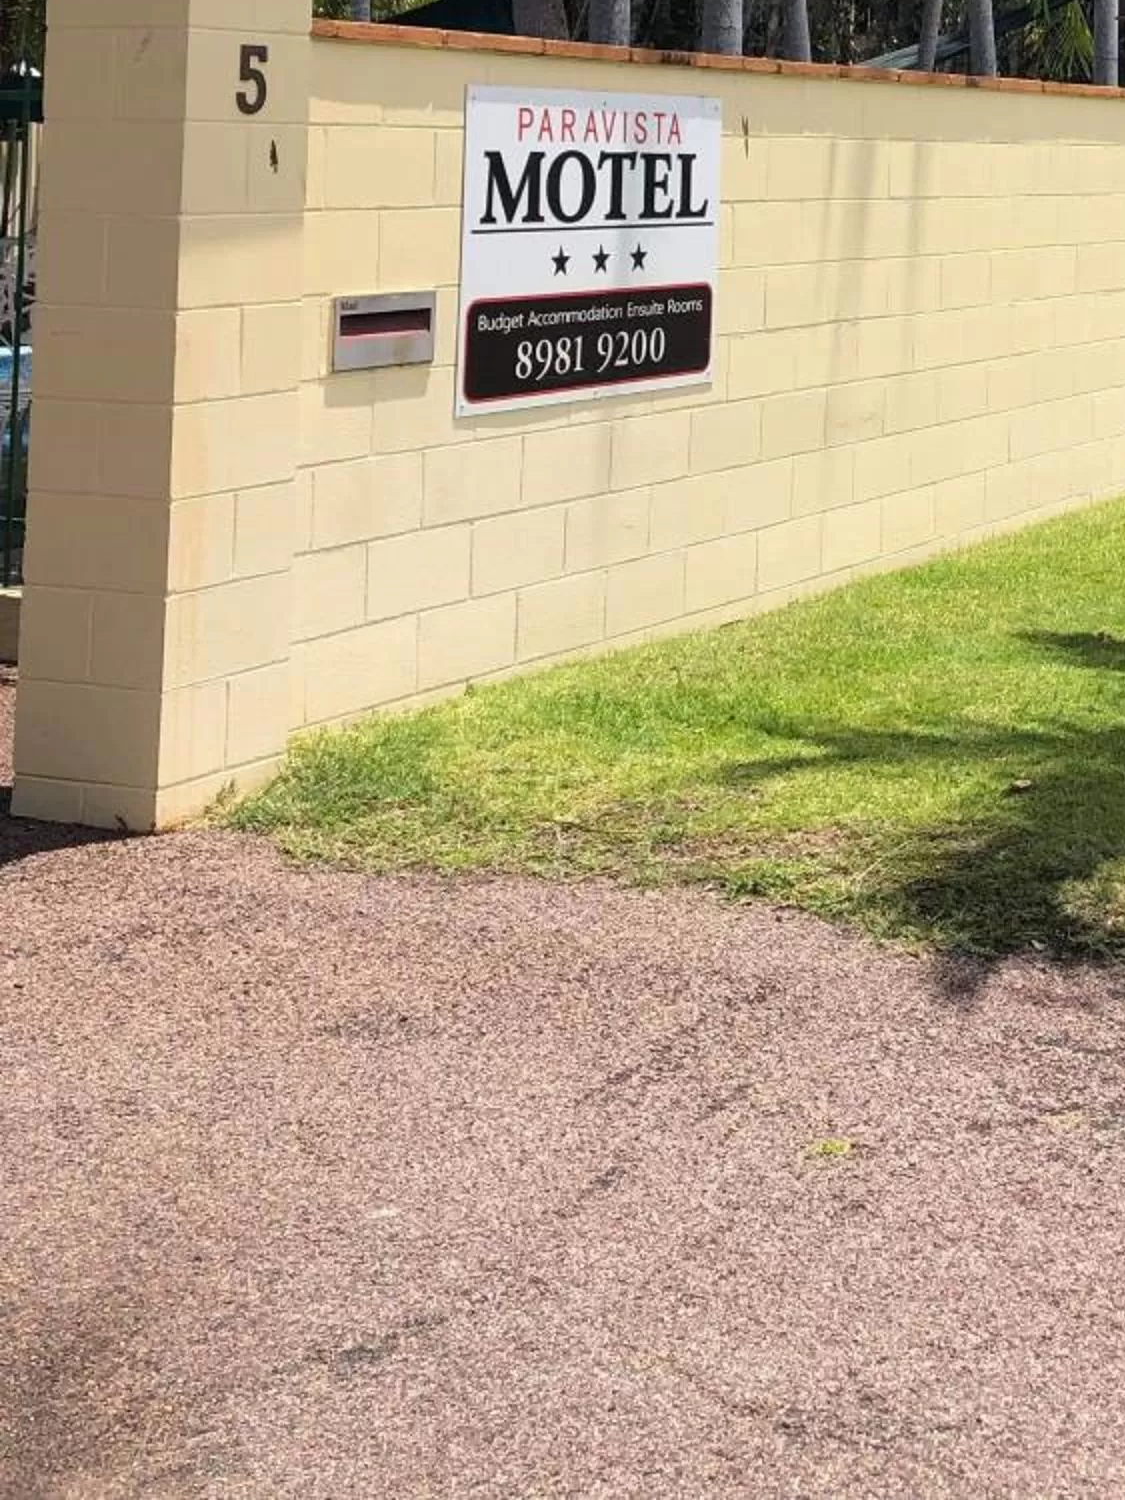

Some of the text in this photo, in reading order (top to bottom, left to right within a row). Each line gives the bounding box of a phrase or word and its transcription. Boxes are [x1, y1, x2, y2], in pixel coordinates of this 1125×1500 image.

[235, 44, 268, 115] 5
[517, 107, 682, 145] PARAVISTA
[479, 150, 709, 224] MOTEL
[477, 299, 703, 334] Budget Accommodation Ensuite Rooms
[515, 327, 667, 381] 8981 9200
